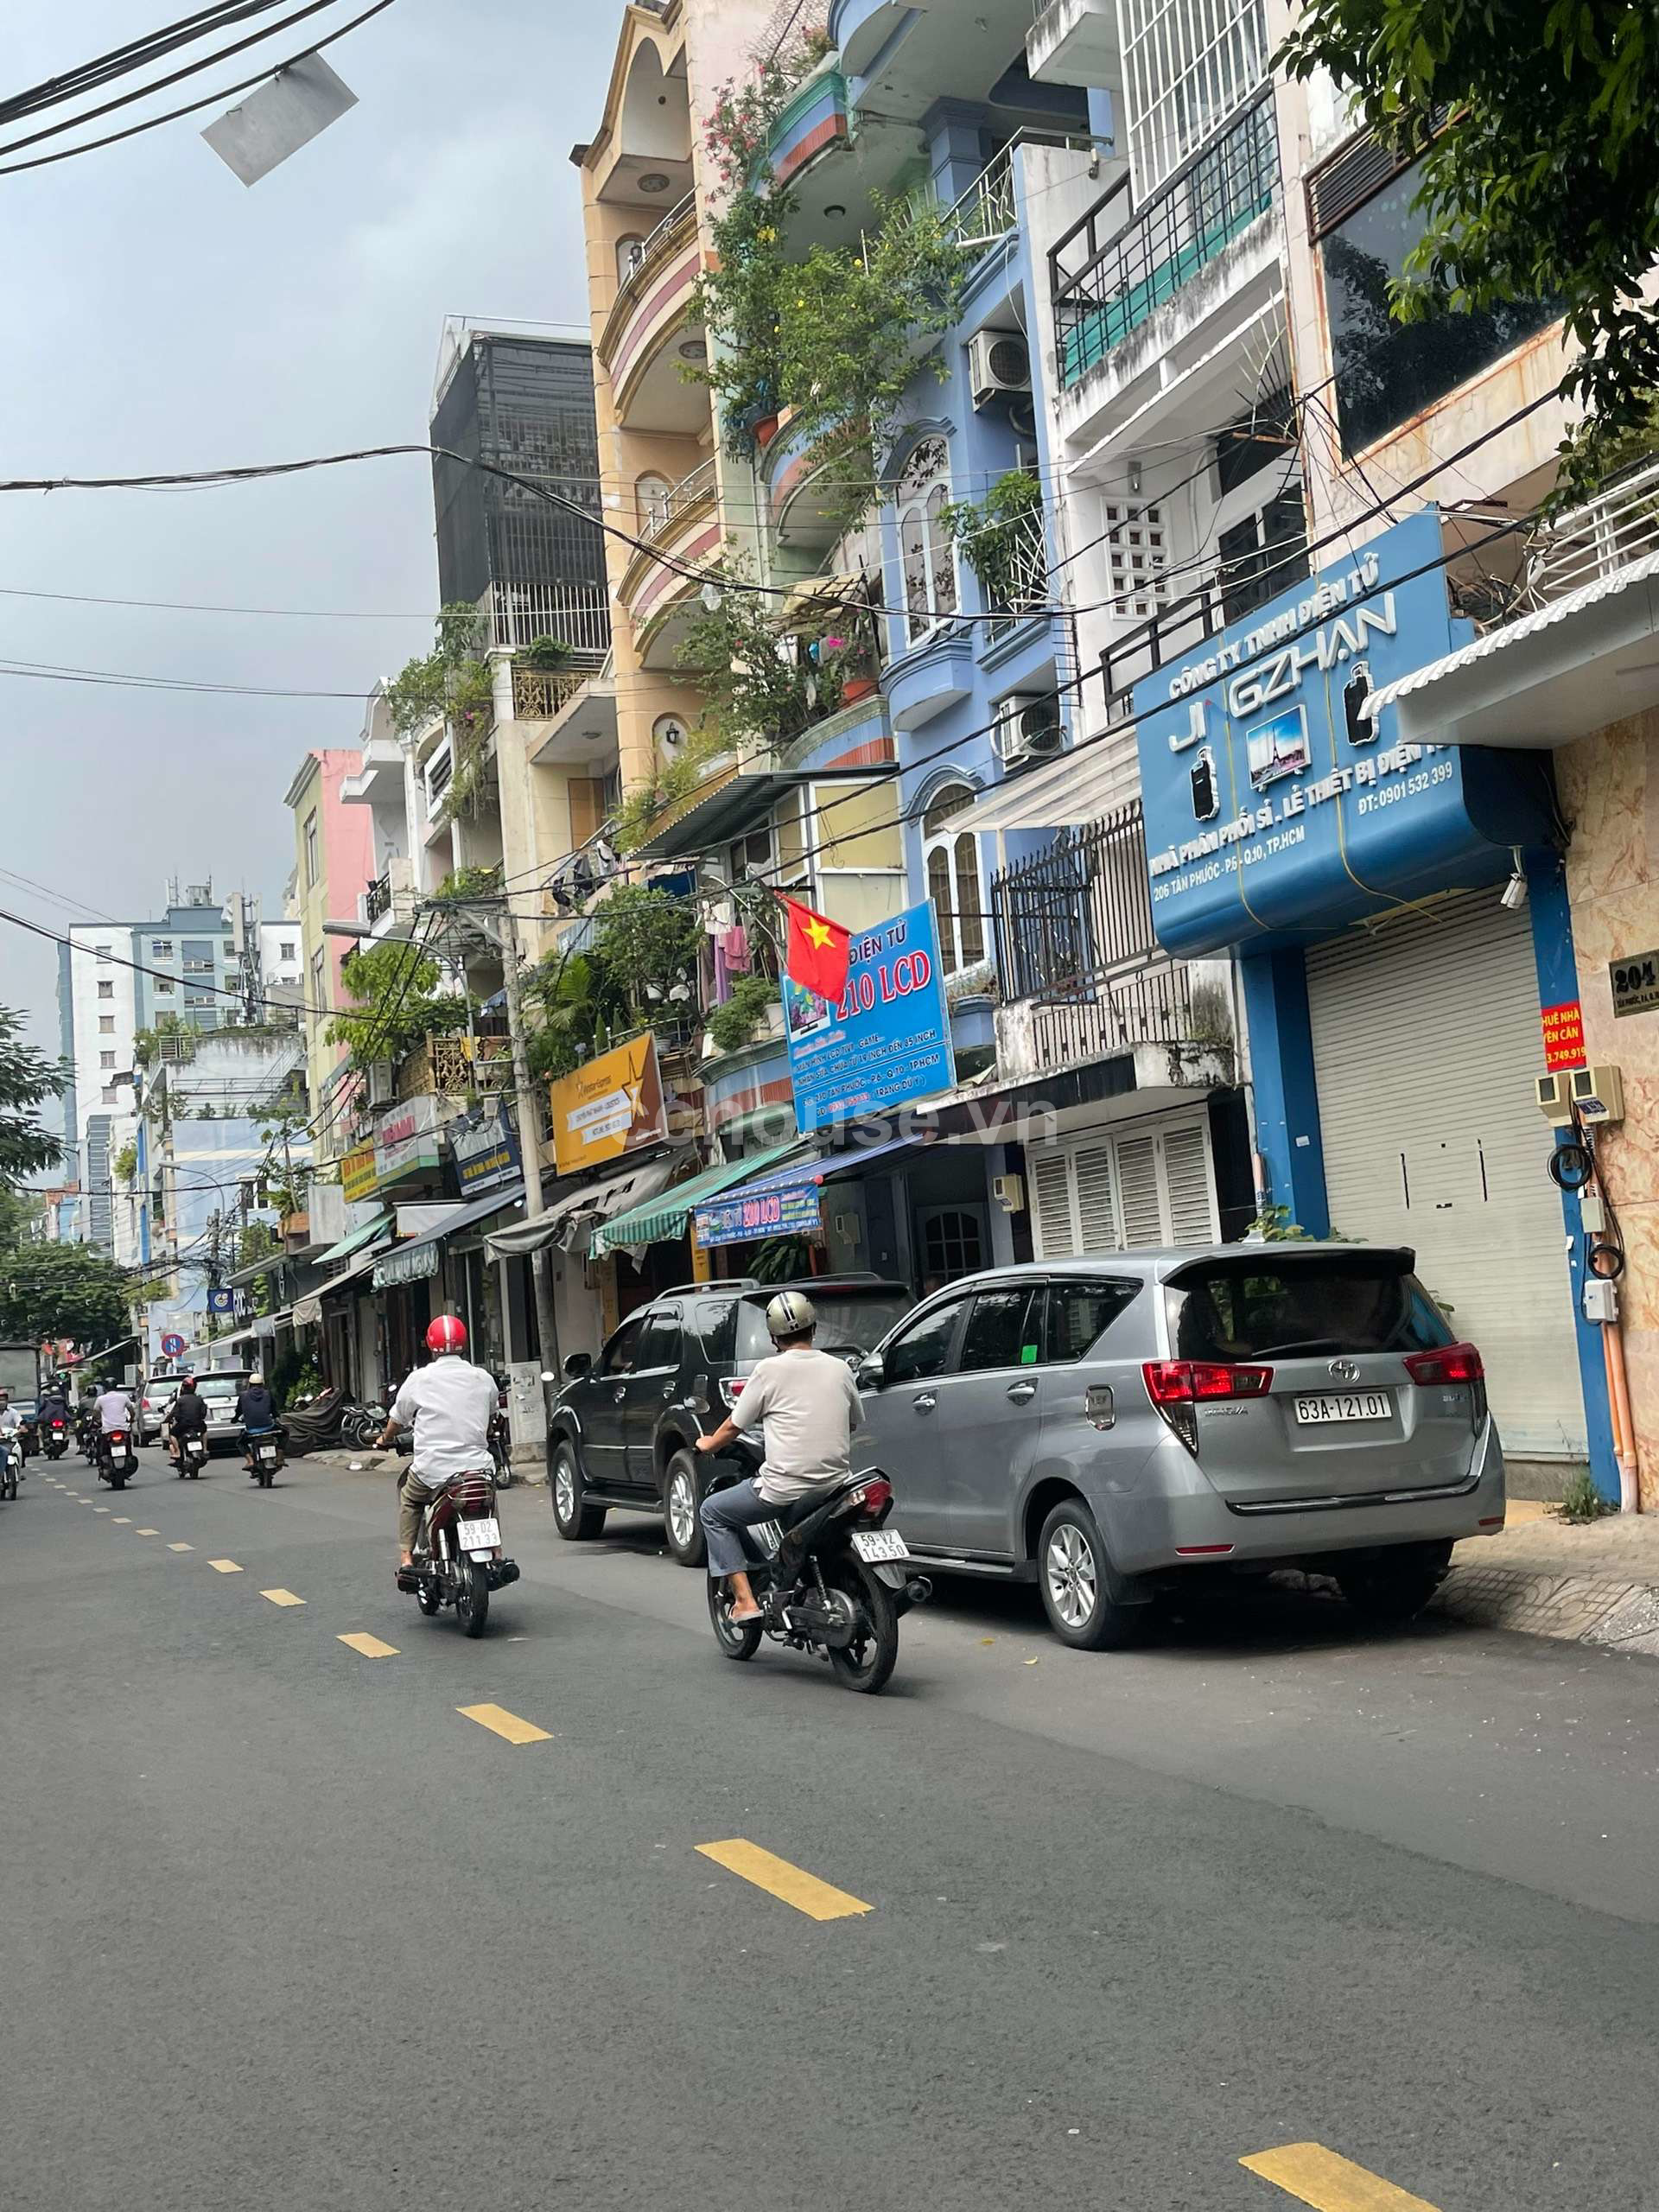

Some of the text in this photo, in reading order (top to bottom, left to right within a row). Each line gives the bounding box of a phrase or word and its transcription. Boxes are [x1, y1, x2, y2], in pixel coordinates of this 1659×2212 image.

[1169, 658, 1217, 700] CÔNG
[1216, 639, 1243, 672] TY
[1244, 608, 1298, 655] TNHH
[1408, 772, 1430, 796] 532
[1431, 761, 1453, 785] 399
[1179, 832, 1219, 865] PHÂN
[1354, 759, 1377, 786] BỊ
[1154, 883, 1170, 902] 206
[886, 918, 907, 950] TỬ
[879, 950, 932, 1003] LCD
[1614, 960, 1656, 993] 204
[1560, 1007, 1581, 1023] NHÀ
[914, 1028, 938, 1044] INCH
[1298, 1394, 1388, 1420] 63A-121.01
[861, 1533, 895, 1547] 59-V2
